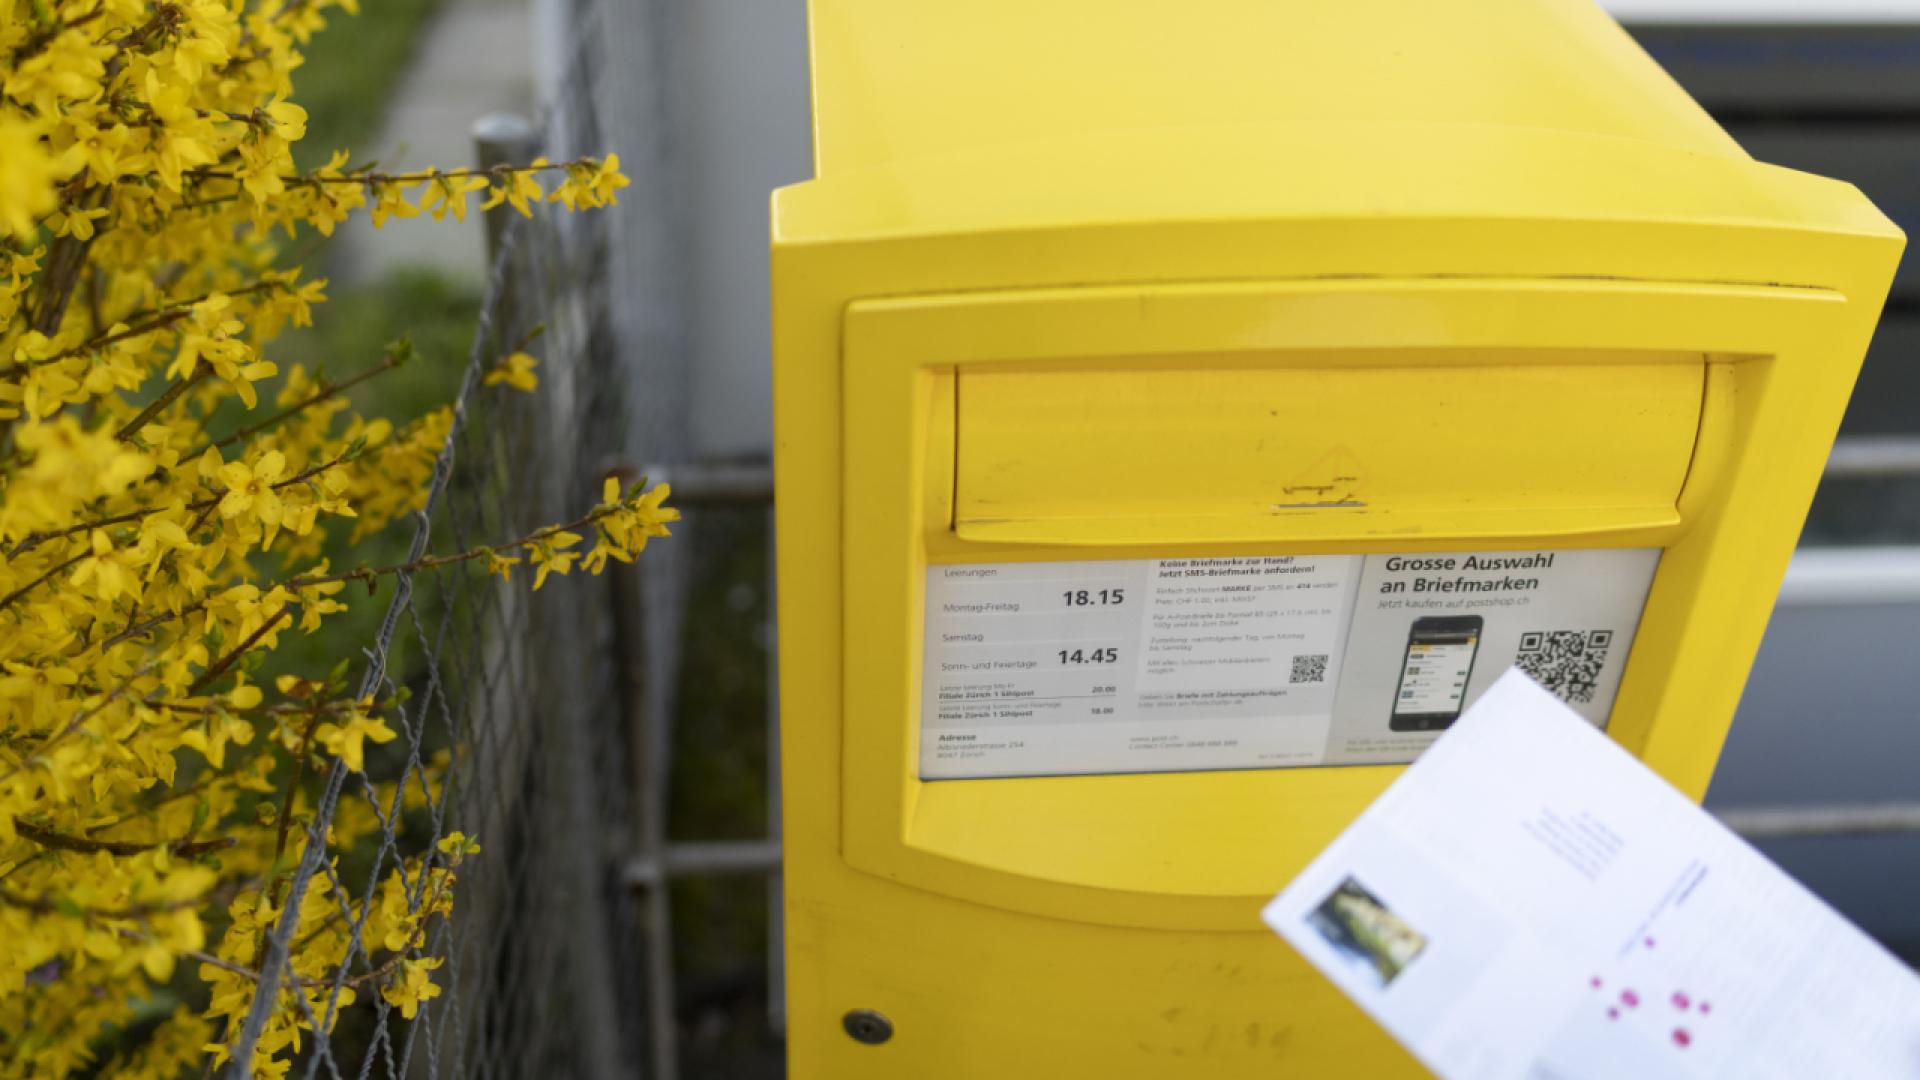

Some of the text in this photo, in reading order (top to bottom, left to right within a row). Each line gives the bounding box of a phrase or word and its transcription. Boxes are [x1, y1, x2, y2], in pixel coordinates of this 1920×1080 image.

[1159, 556, 1295, 568] Keine Briefmarke zur Hand?
[1385, 553, 1555, 572] Grosse Auswahl
[944, 568, 997, 578] Leerungen
[1158, 565, 1315, 578] Jetzt SMS-Briefmarke anfordern!
[1222, 584, 1252, 592] MARKE
[1380, 576, 1540, 593] an Briefmarken
[1062, 589, 1125, 606] 18.15
[943, 602, 1020, 613] Montag-Freitag
[1377, 597, 1530, 611] Jetzt kaufen auf postshop.ch
[942, 633, 984, 643] Samstag
[1058, 648, 1119, 665] 14.45
[941, 660, 1038, 671] Sonn- und Feiertage
[938, 691, 963, 700] Filiale
[965, 690, 991, 699] Zürich
[1092, 685, 1117, 694] 20.00
[1176, 692, 1200, 700] Briefe
[1201, 691, 1214, 699] mit
[938, 712, 963, 720] Filiale
[964, 711, 990, 720] Zürich
[939, 734, 977, 742] Adresse
